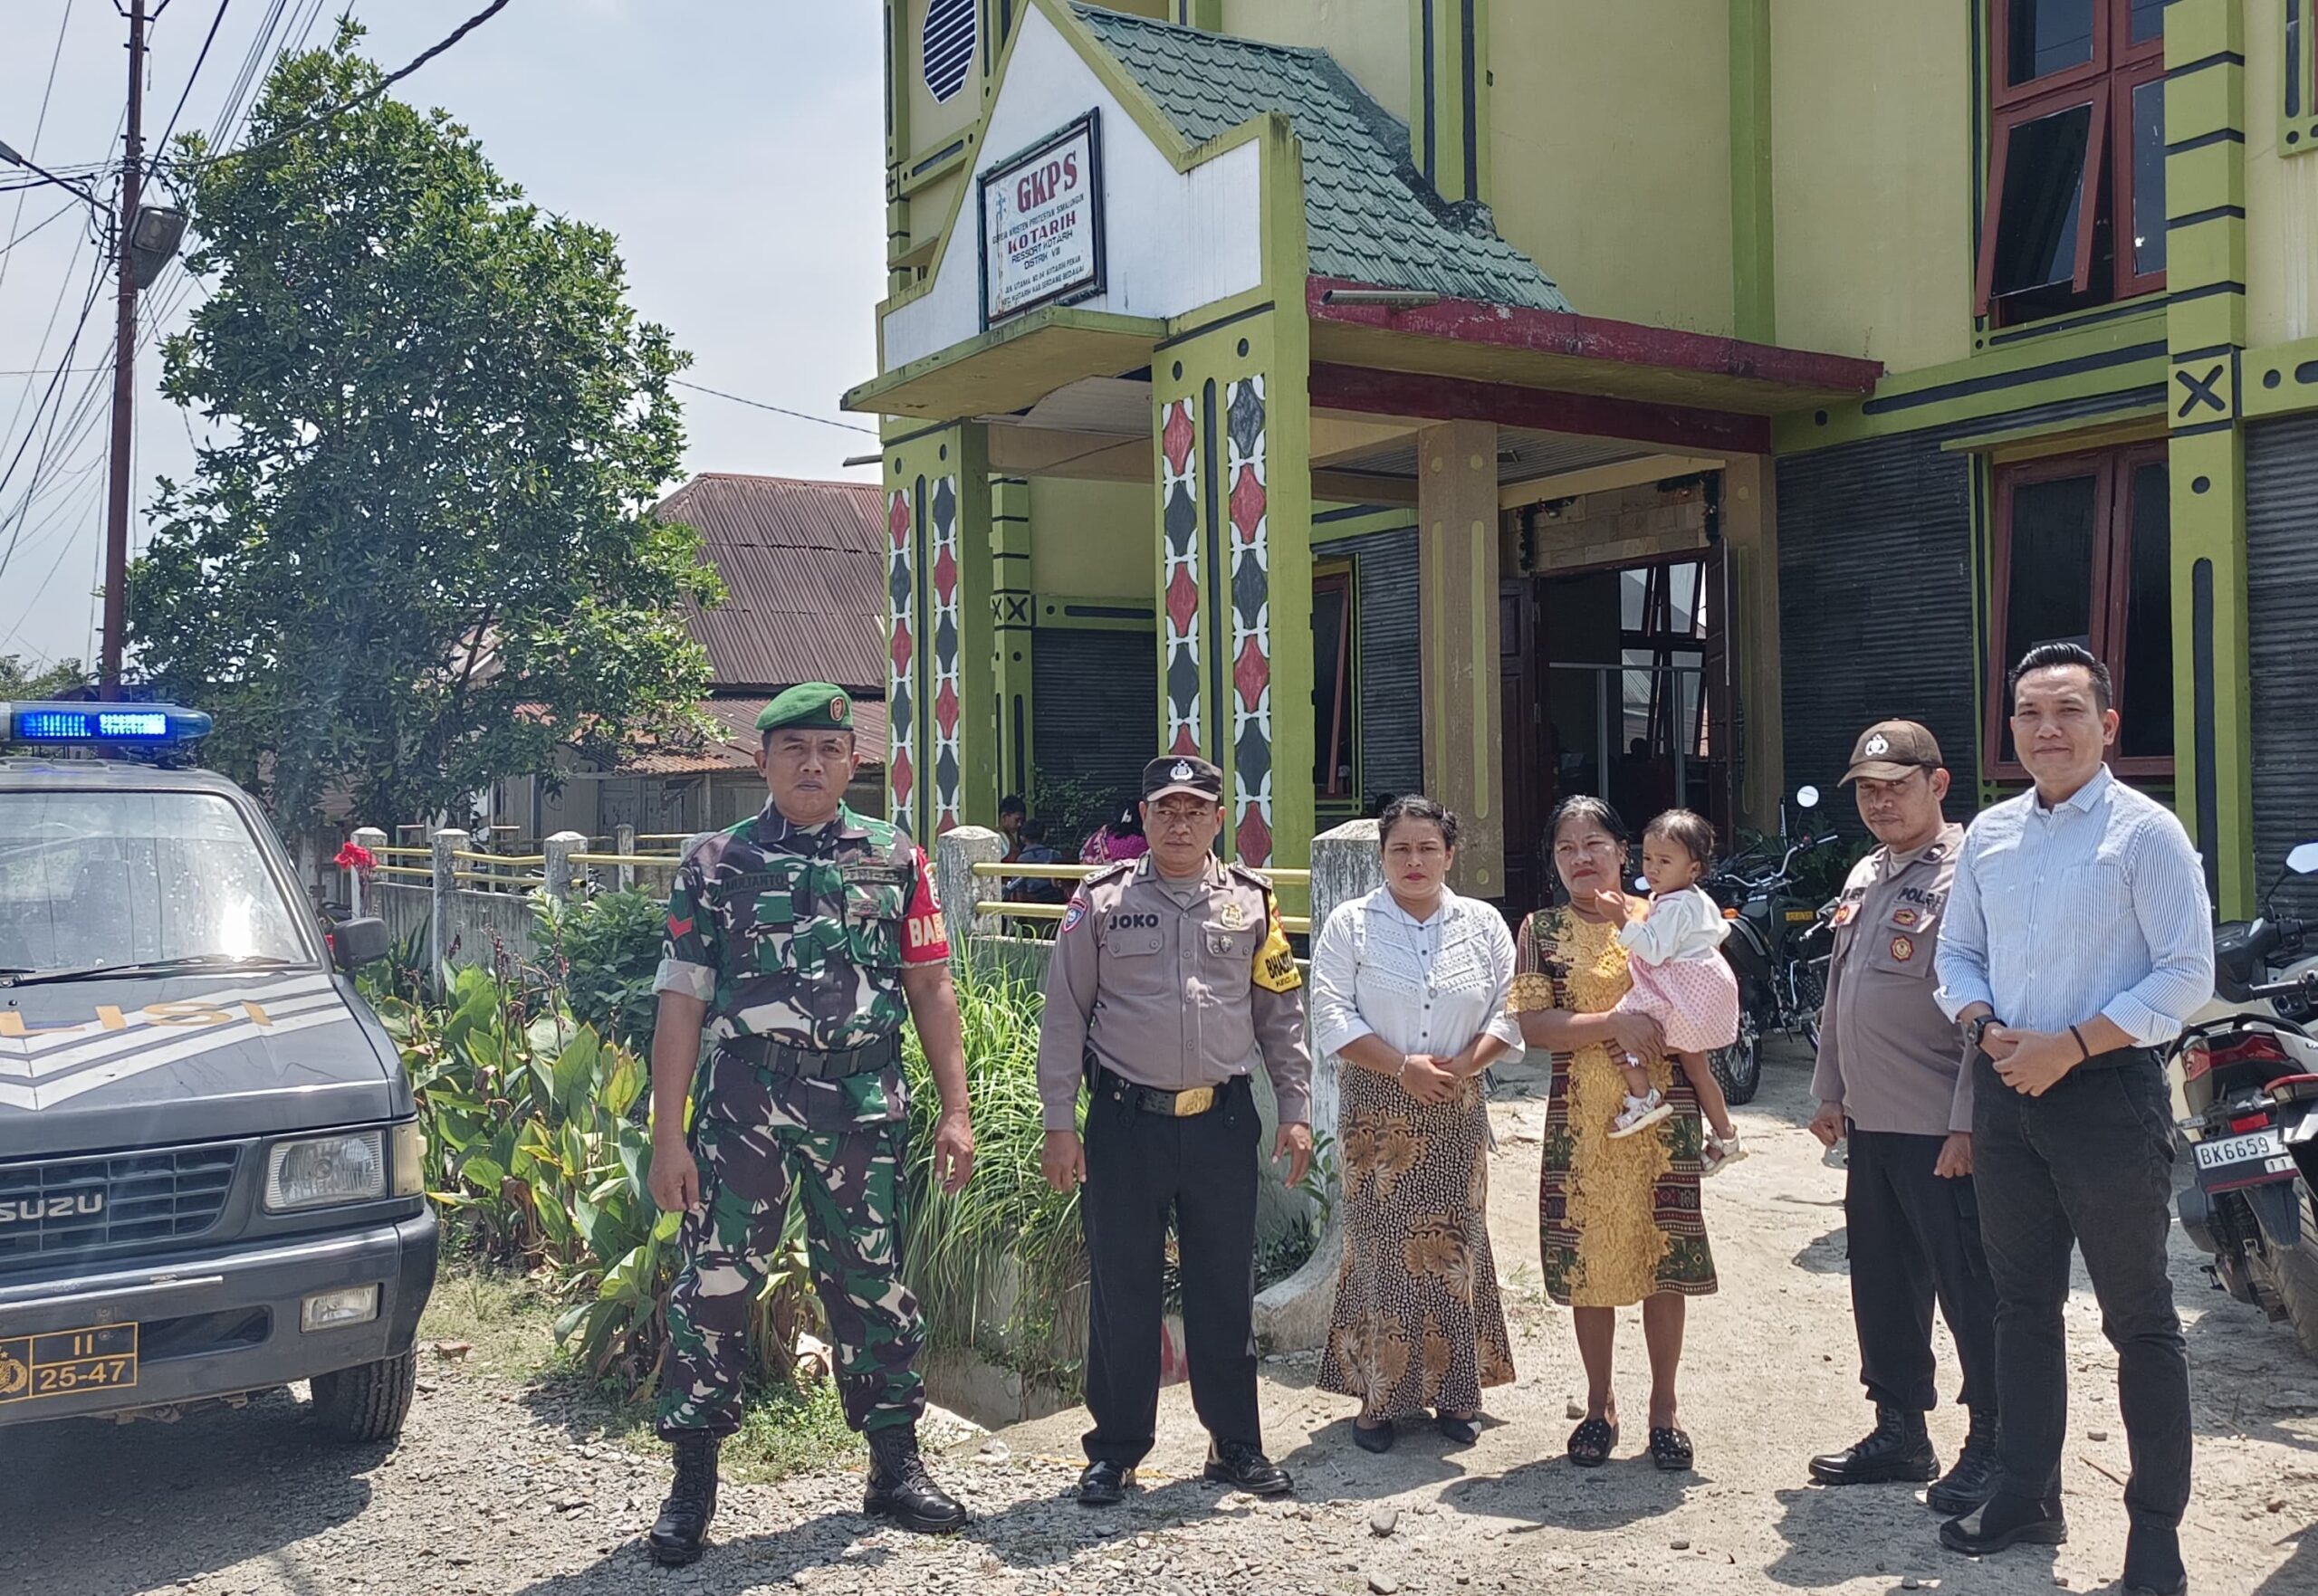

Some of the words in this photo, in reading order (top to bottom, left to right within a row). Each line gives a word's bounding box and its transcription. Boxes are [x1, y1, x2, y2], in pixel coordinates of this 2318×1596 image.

[1017, 150, 1078, 214] GKPS
[1008, 210, 1076, 254] KOTARIH
[1011, 243, 1041, 264] RESSORT
[1042, 229, 1073, 250] KOTARIH
[1109, 913, 1159, 931] JOKO
[40, 1361, 126, 1391] 25-47
